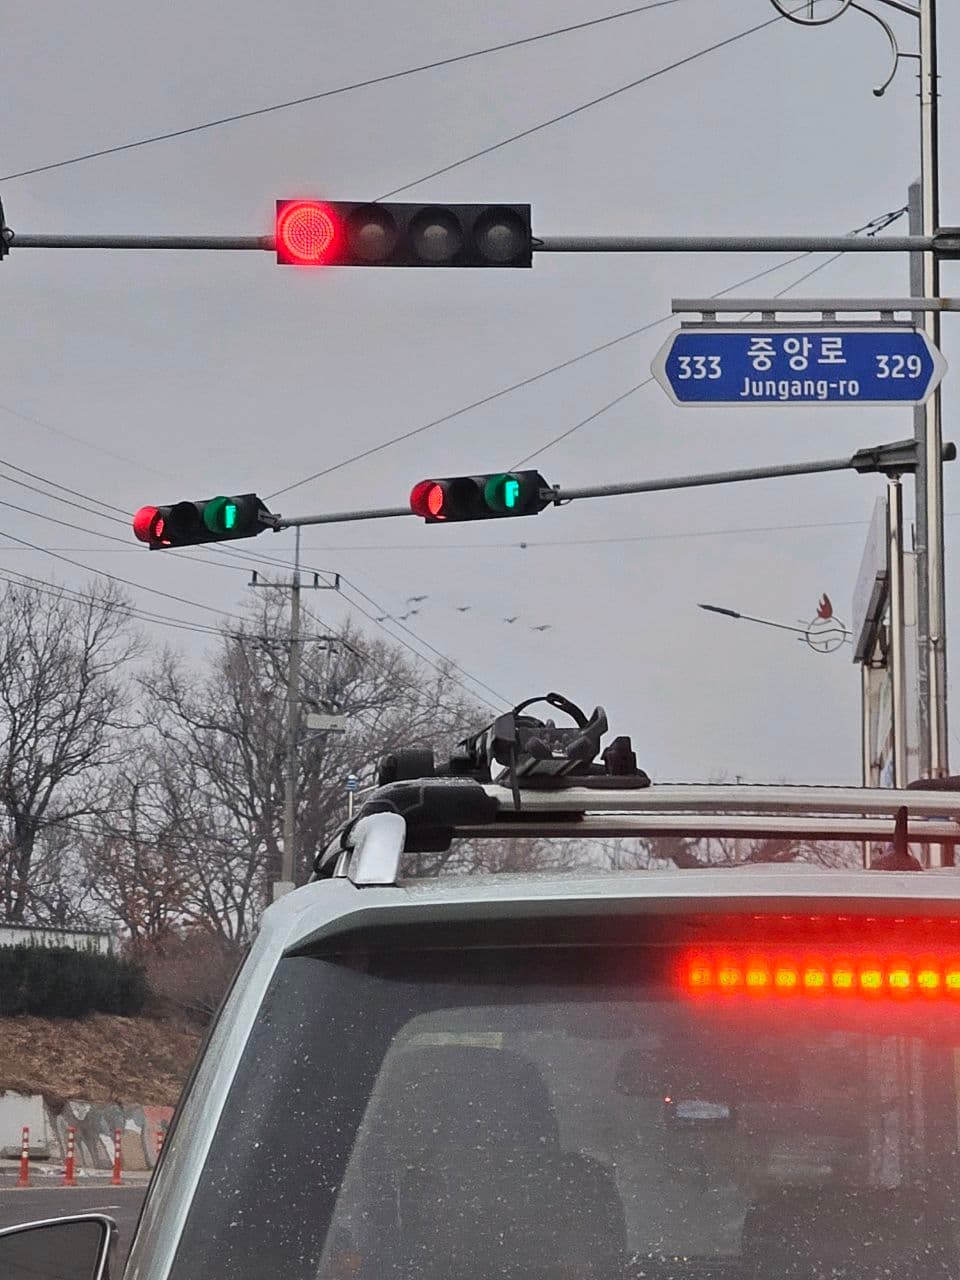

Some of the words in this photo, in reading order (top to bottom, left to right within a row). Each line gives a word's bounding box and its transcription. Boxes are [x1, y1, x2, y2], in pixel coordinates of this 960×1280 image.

[747, 336, 847, 372] 중앙로
[875, 354, 923, 379] 329
[677, 355, 722, 380] 333
[740, 377, 860, 400] Jungang-ro
